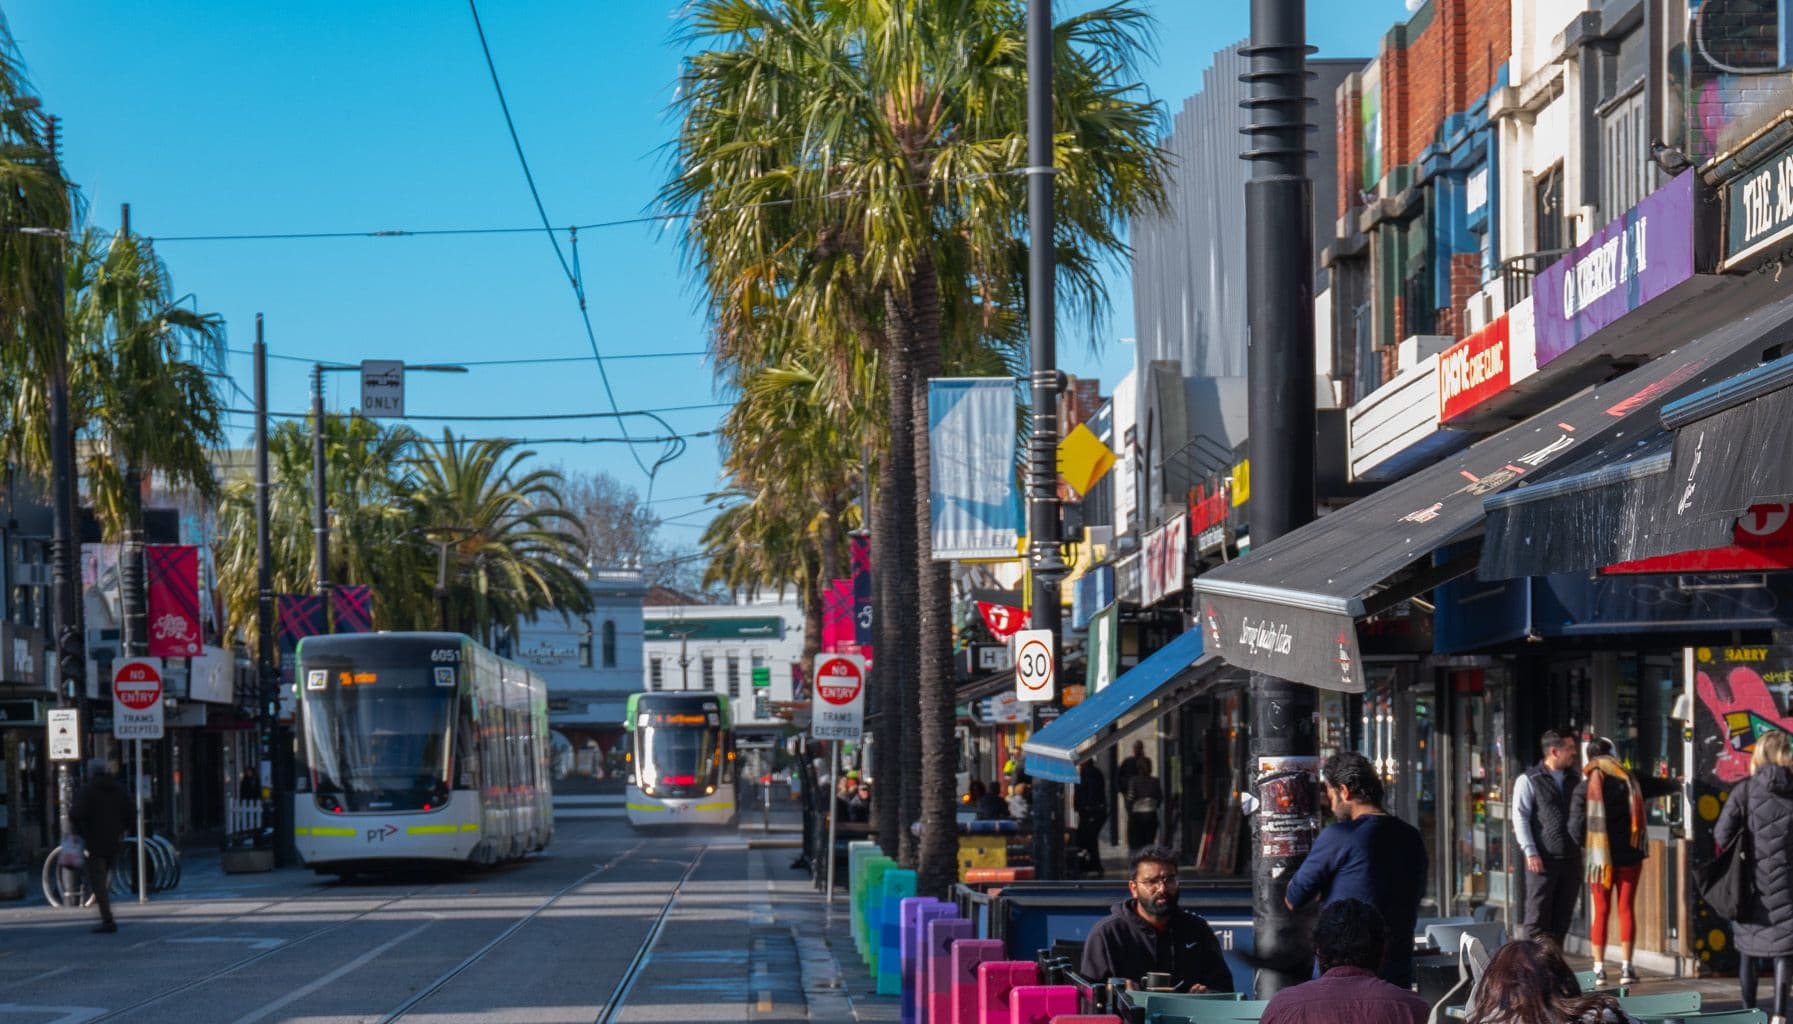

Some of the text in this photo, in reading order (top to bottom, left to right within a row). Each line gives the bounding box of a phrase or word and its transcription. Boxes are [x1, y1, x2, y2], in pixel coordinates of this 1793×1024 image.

[1743, 170, 1773, 242] THE
[365, 396, 400, 409] ONLY
[431, 649, 460, 661] 6051
[831, 664, 848, 676] NO
[1023, 653, 1047, 677] 30
[130, 669, 145, 681] NO
[121, 692, 155, 703] ENTRY
[822, 687, 855, 698] ENTRY
[123, 714, 154, 723] TRAMS
[823, 711, 853, 722] TRAMS
[119, 725, 159, 734] EXCEPTED
[815, 726, 860, 737] EXCEPTED
